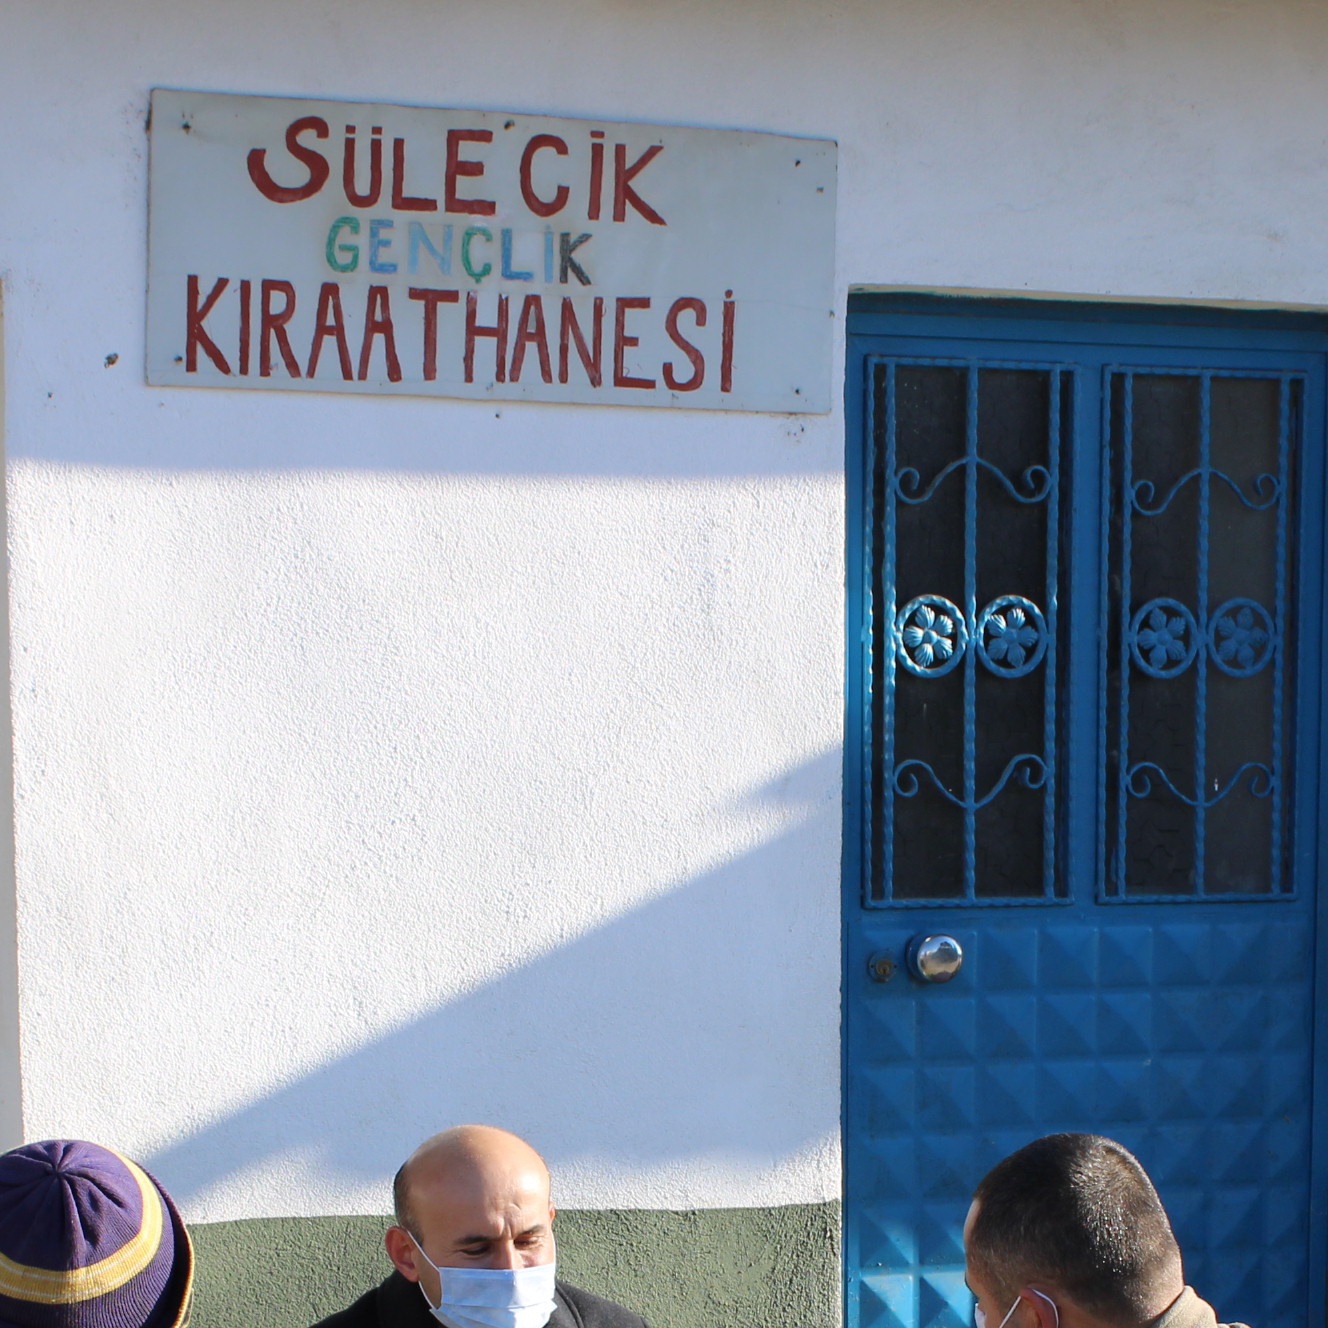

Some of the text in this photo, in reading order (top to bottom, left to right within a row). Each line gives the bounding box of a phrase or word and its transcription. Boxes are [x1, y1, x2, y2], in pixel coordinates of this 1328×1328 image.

[247, 115, 668, 226] SÜLECİK
[325, 215, 592, 287] GENÇLİK
[185, 274, 737, 393] KIRAATHANESİ
